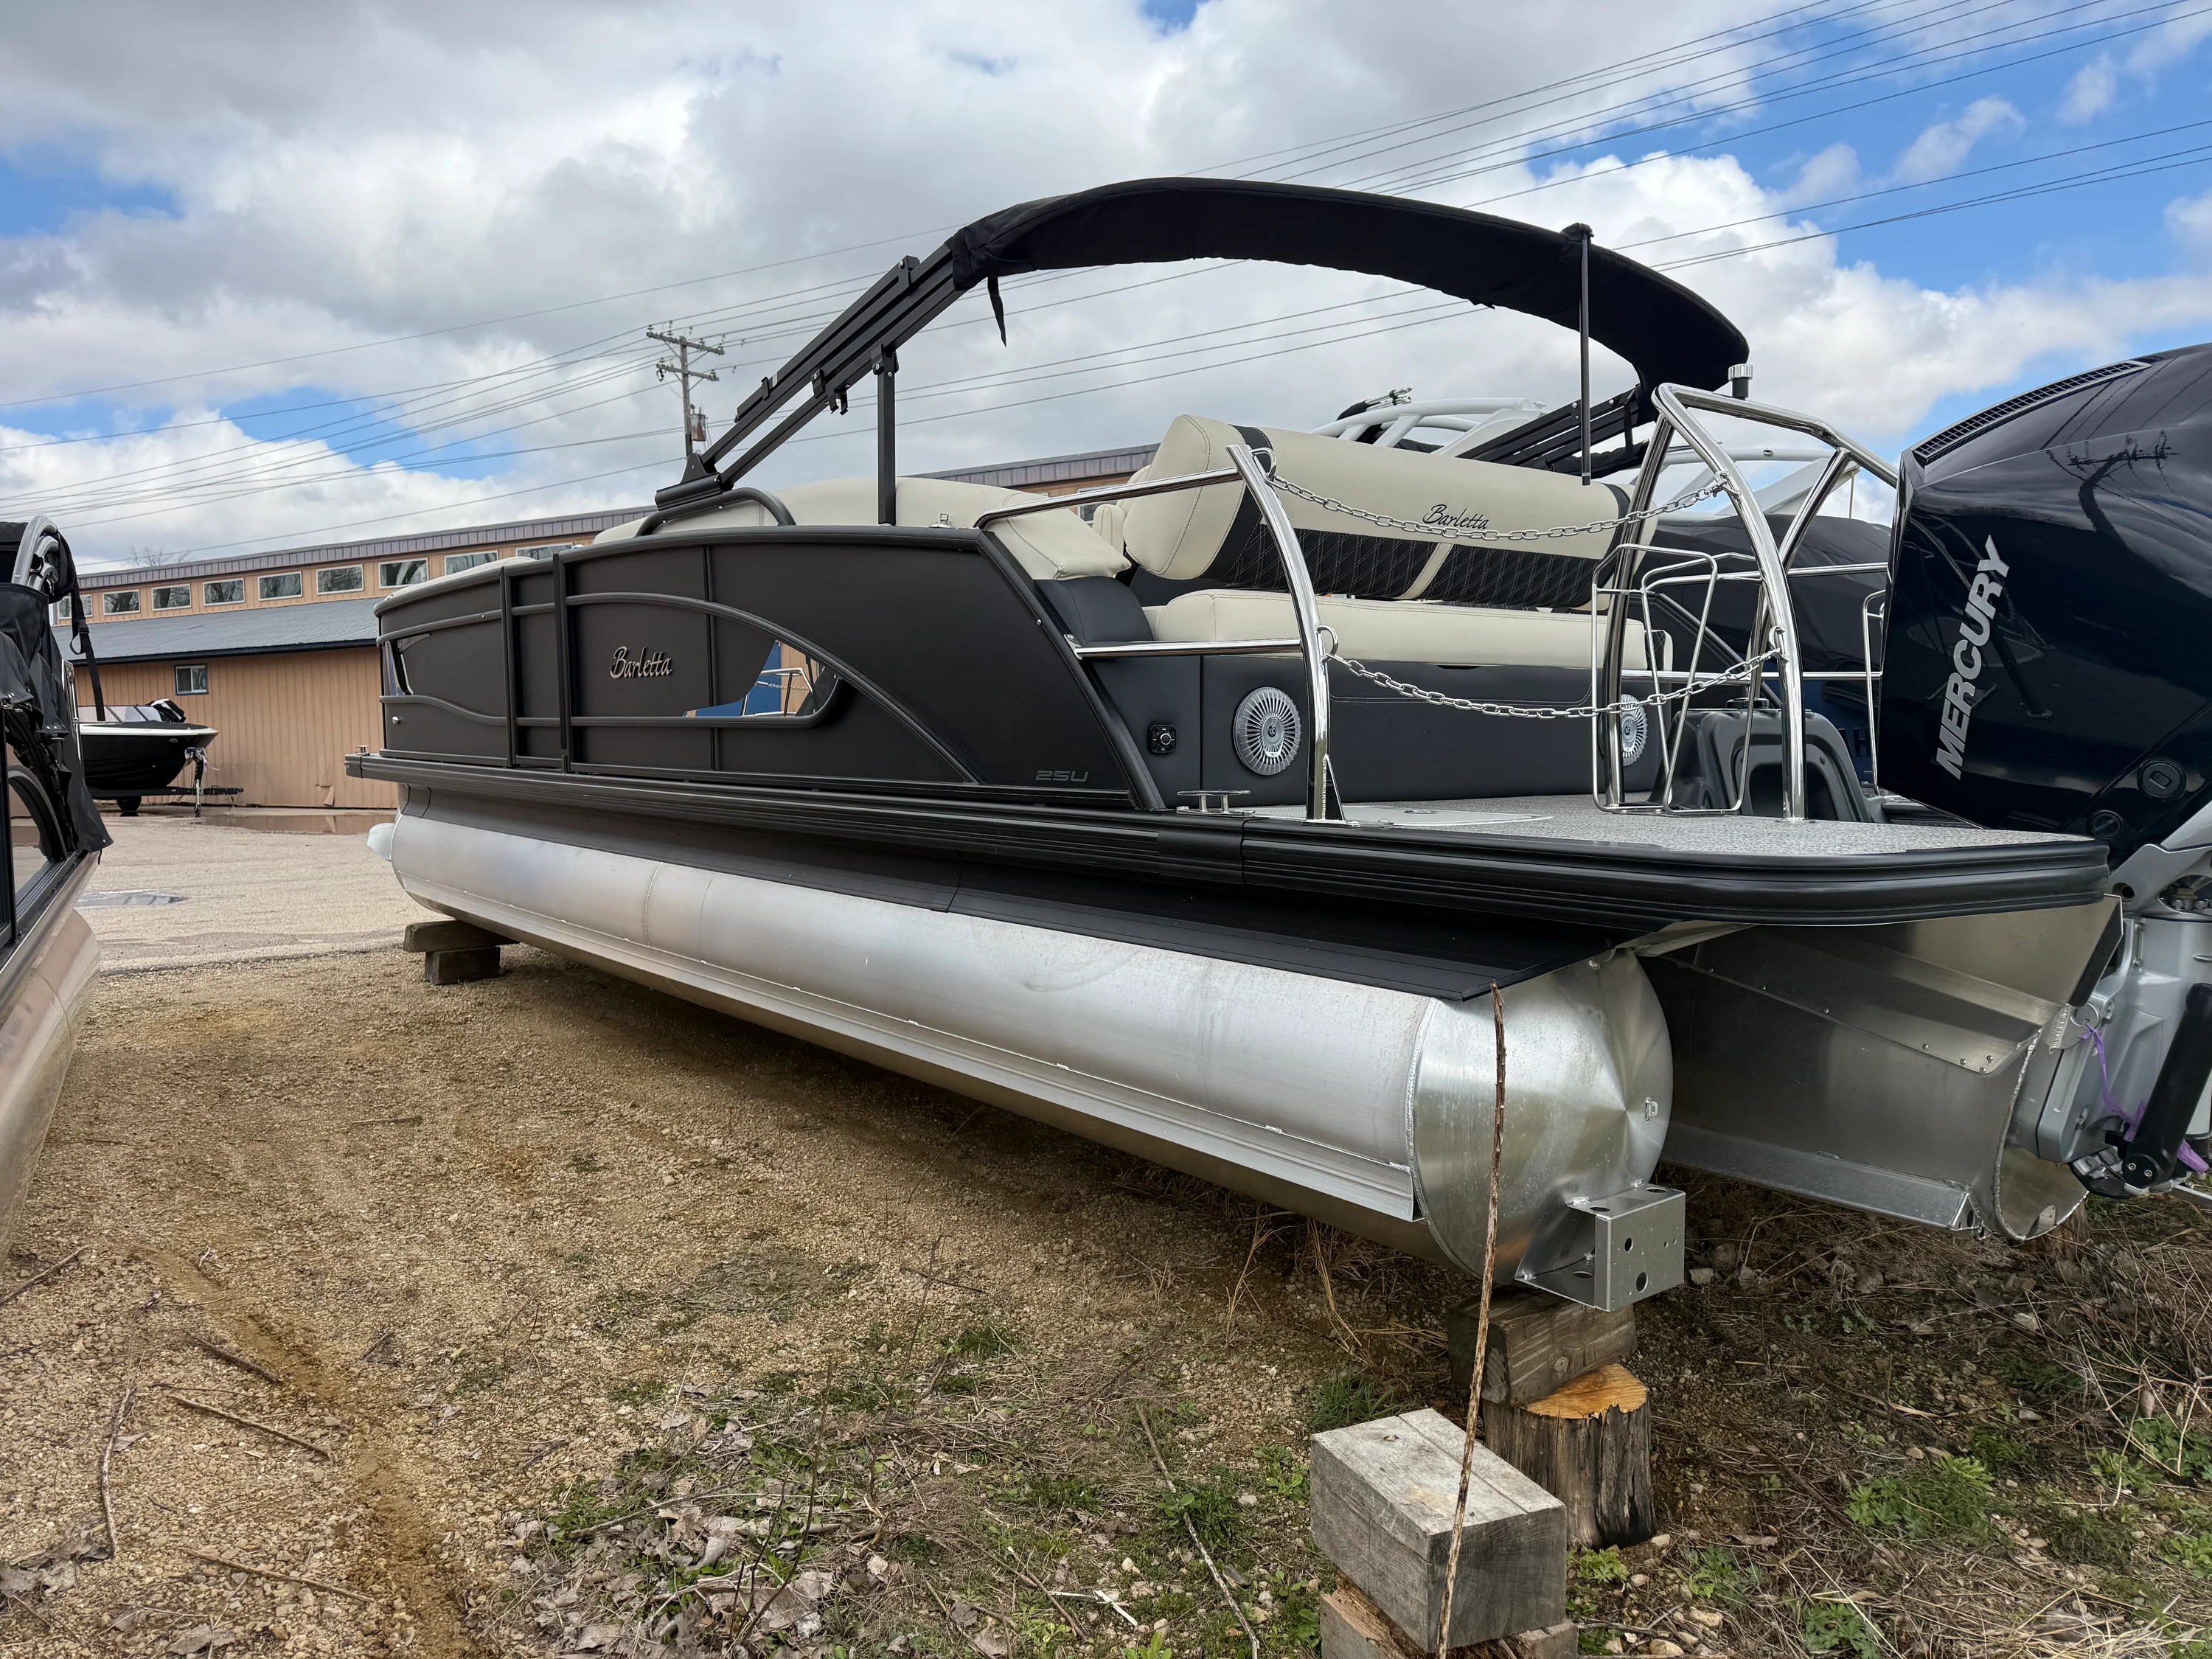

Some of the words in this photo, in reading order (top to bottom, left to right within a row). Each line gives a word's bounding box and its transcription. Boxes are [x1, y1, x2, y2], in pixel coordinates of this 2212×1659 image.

[1422, 504, 1489, 529] Barletta
[610, 646, 672, 679] Barletta
[1936, 535, 2010, 780] MERCURY
[1035, 770, 1089, 782] 25U
